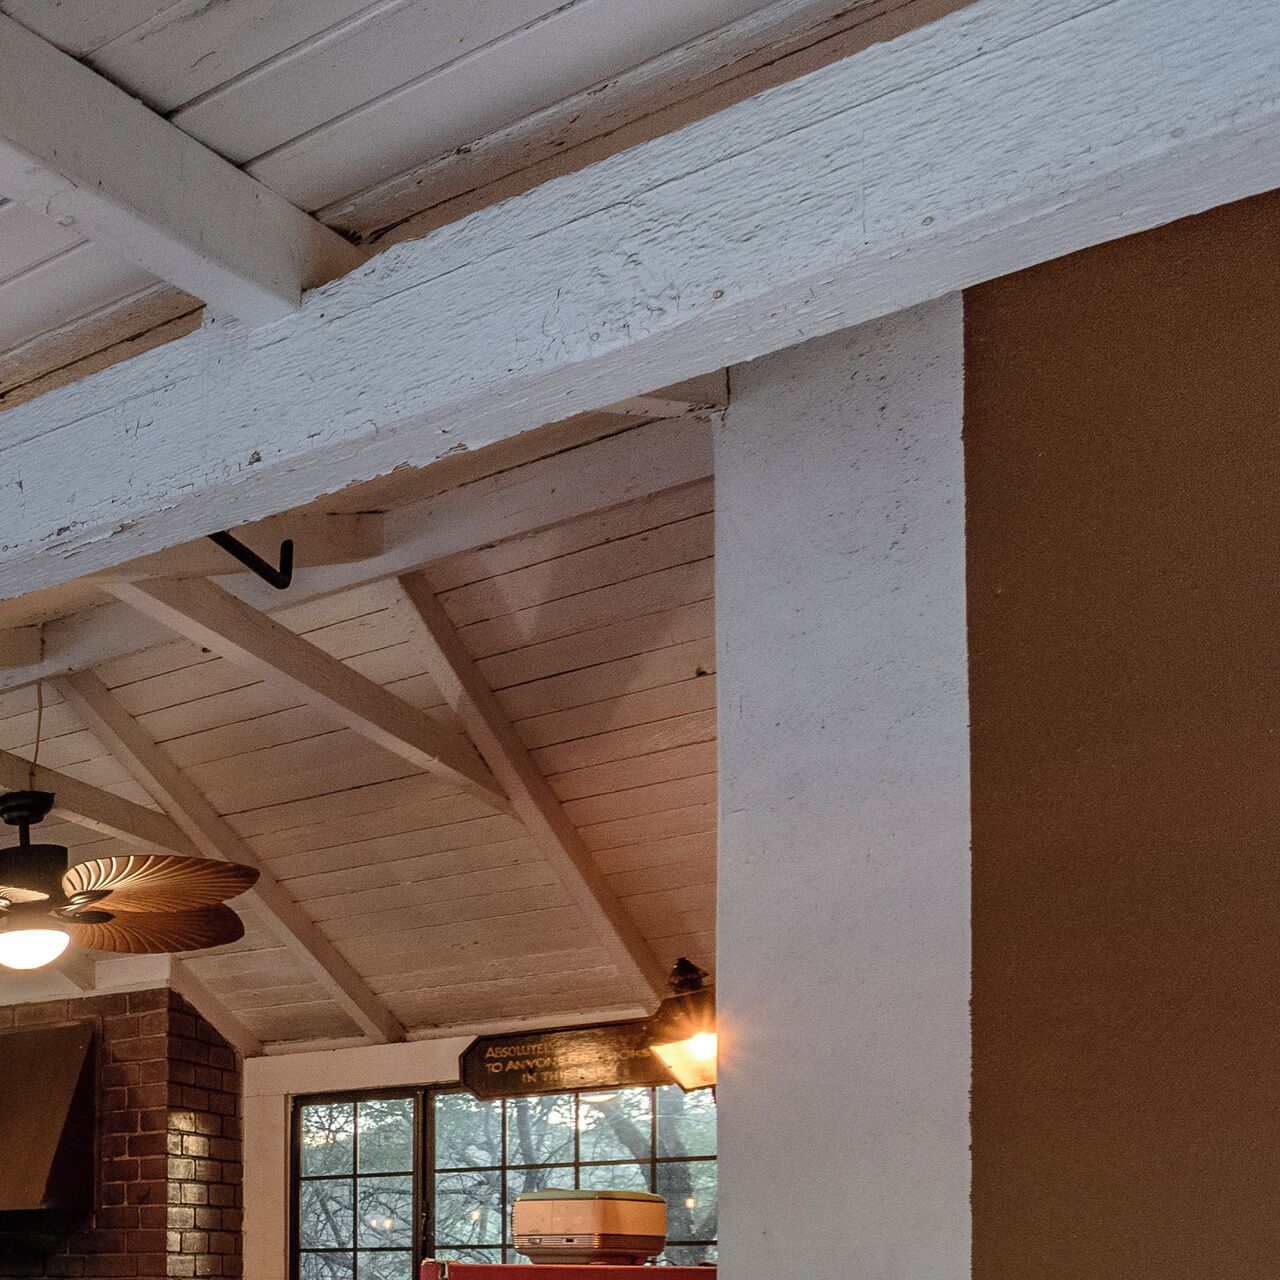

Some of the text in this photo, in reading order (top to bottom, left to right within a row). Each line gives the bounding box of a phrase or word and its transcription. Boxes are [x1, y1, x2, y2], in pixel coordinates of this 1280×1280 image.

[485, 1042, 555, 1058] ABSOLUTELY
[486, 1062, 502, 1073] TO
[505, 1056, 564, 1072] ANYONE
[522, 1072, 537, 1083] IN
